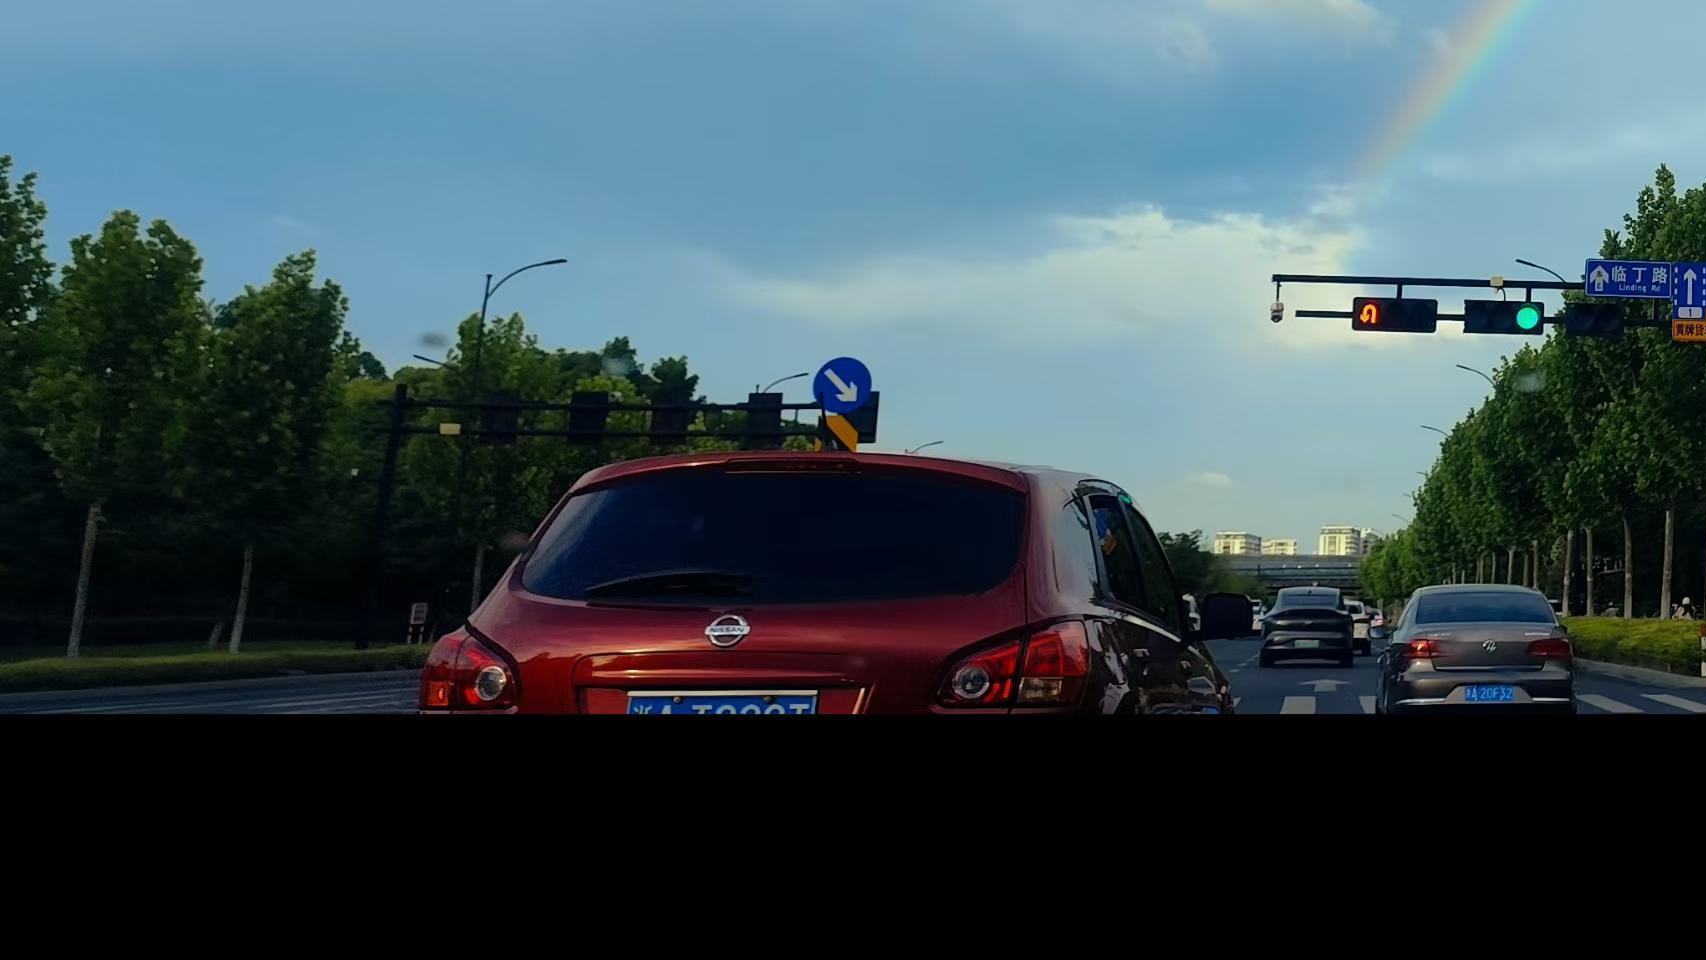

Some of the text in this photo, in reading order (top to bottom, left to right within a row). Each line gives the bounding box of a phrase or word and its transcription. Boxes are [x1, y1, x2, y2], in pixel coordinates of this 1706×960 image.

[1611, 265, 1668, 284] 临丁路
[1618, 283, 1647, 293] Linding
